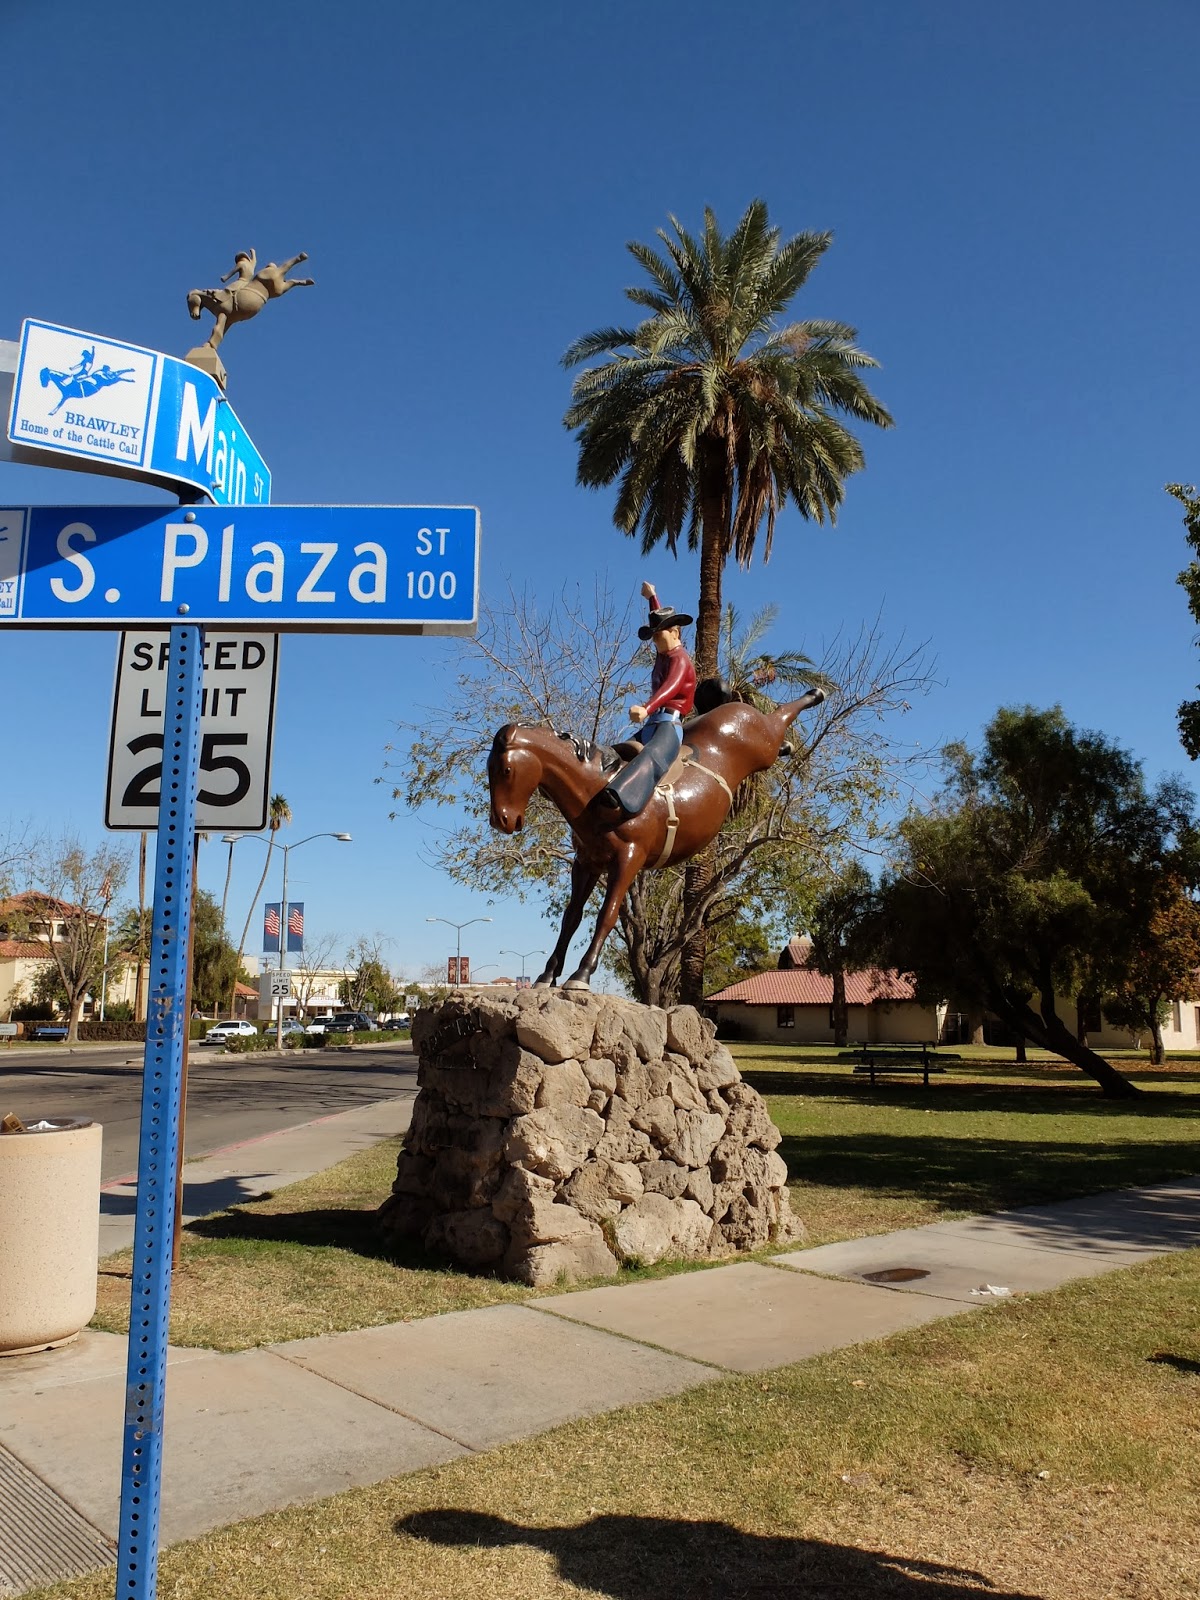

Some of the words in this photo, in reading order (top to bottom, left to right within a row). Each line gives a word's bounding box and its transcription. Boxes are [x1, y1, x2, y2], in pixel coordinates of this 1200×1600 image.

[20, 419, 49, 436] Home
[52, 427, 64, 439] of
[67, 430, 83, 442] the
[86, 434, 115, 450] Cattle
[119, 441, 138, 455] Call
[65, 411, 141, 439] BRAWLEY
[176, 381, 246, 505] Main
[254, 472, 264, 503] ST
[416, 528, 451, 556] ST
[50, 522, 121, 603] S.
[160, 523, 388, 603] Plaza
[407, 571, 457, 599] 100
[140, 688, 247, 717] LIT
[121, 733, 251, 806] 25
[272, 984, 289, 995] 25
